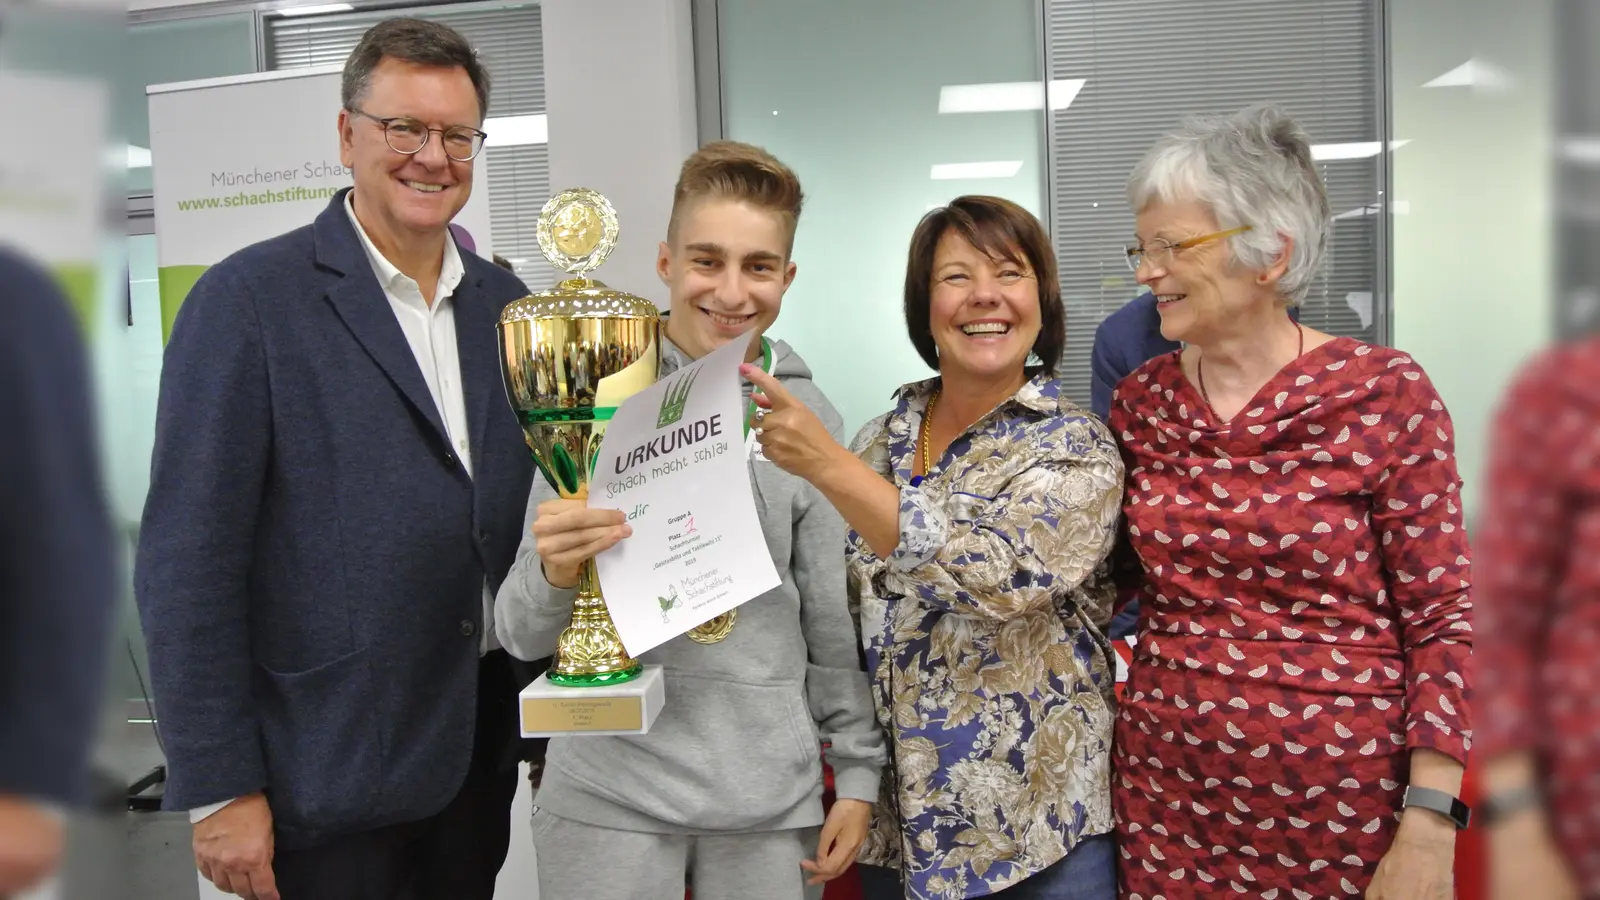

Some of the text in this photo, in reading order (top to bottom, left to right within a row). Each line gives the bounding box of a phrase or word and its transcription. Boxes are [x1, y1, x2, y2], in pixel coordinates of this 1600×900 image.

[211, 167, 299, 188] Münchener
[614, 413, 722, 475] URKUNDE
[606, 473, 646, 499] Schach
[652, 457, 688, 480] macht
[667, 514, 687, 525] Gruppe
[668, 533, 681, 542] Platz
